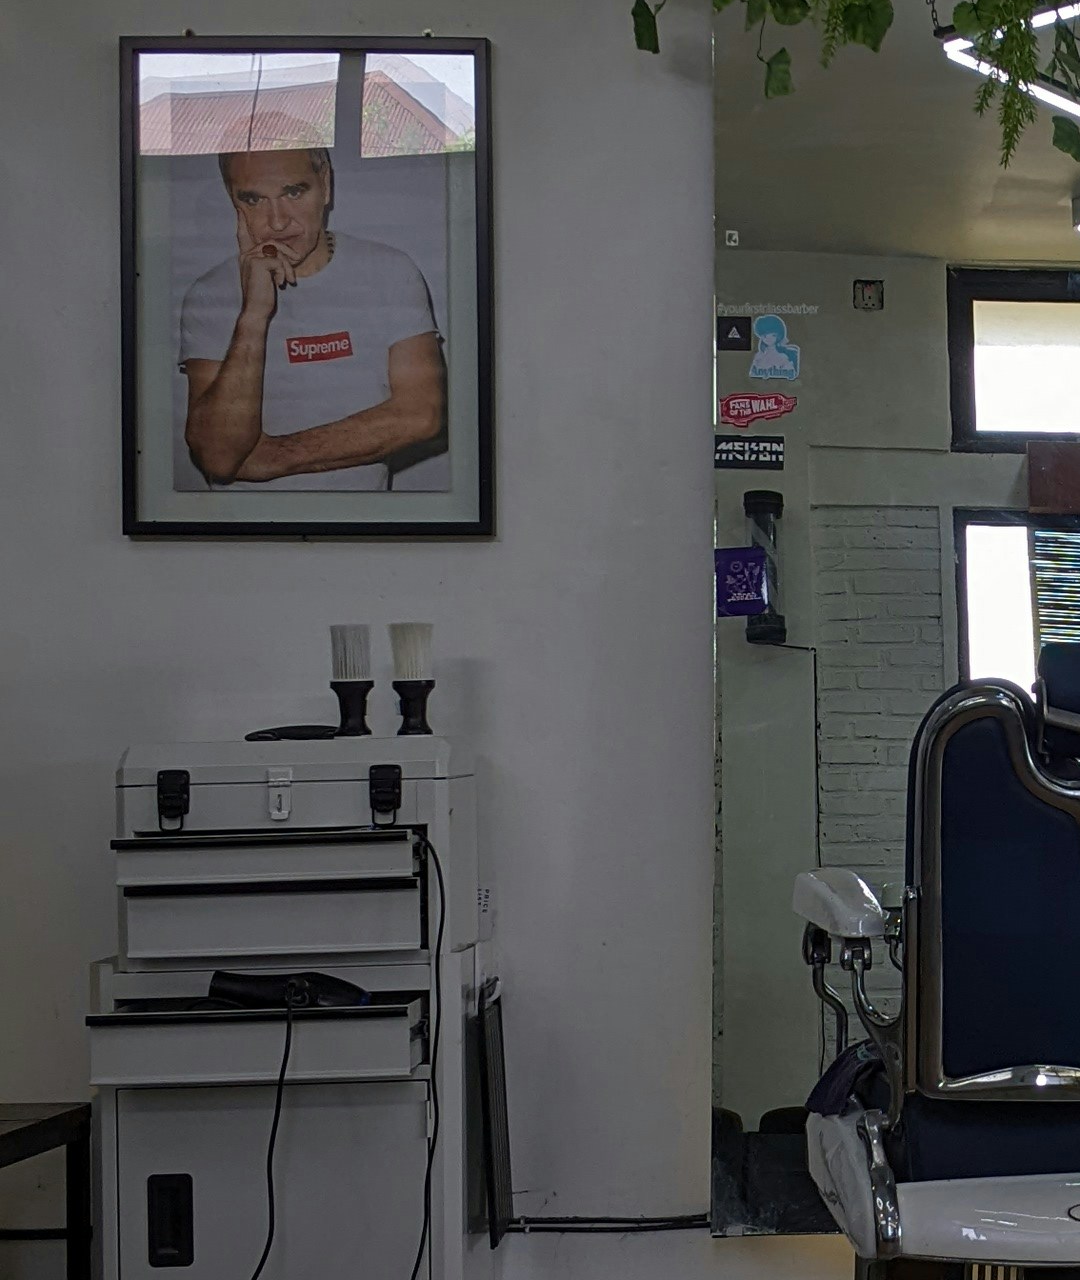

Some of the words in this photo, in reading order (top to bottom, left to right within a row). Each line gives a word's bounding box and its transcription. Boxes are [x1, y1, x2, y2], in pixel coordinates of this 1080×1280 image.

[290, 339, 350, 360] Supreme
[752, 365, 795, 377] Anything
[751, 398, 778, 413] WAHL
